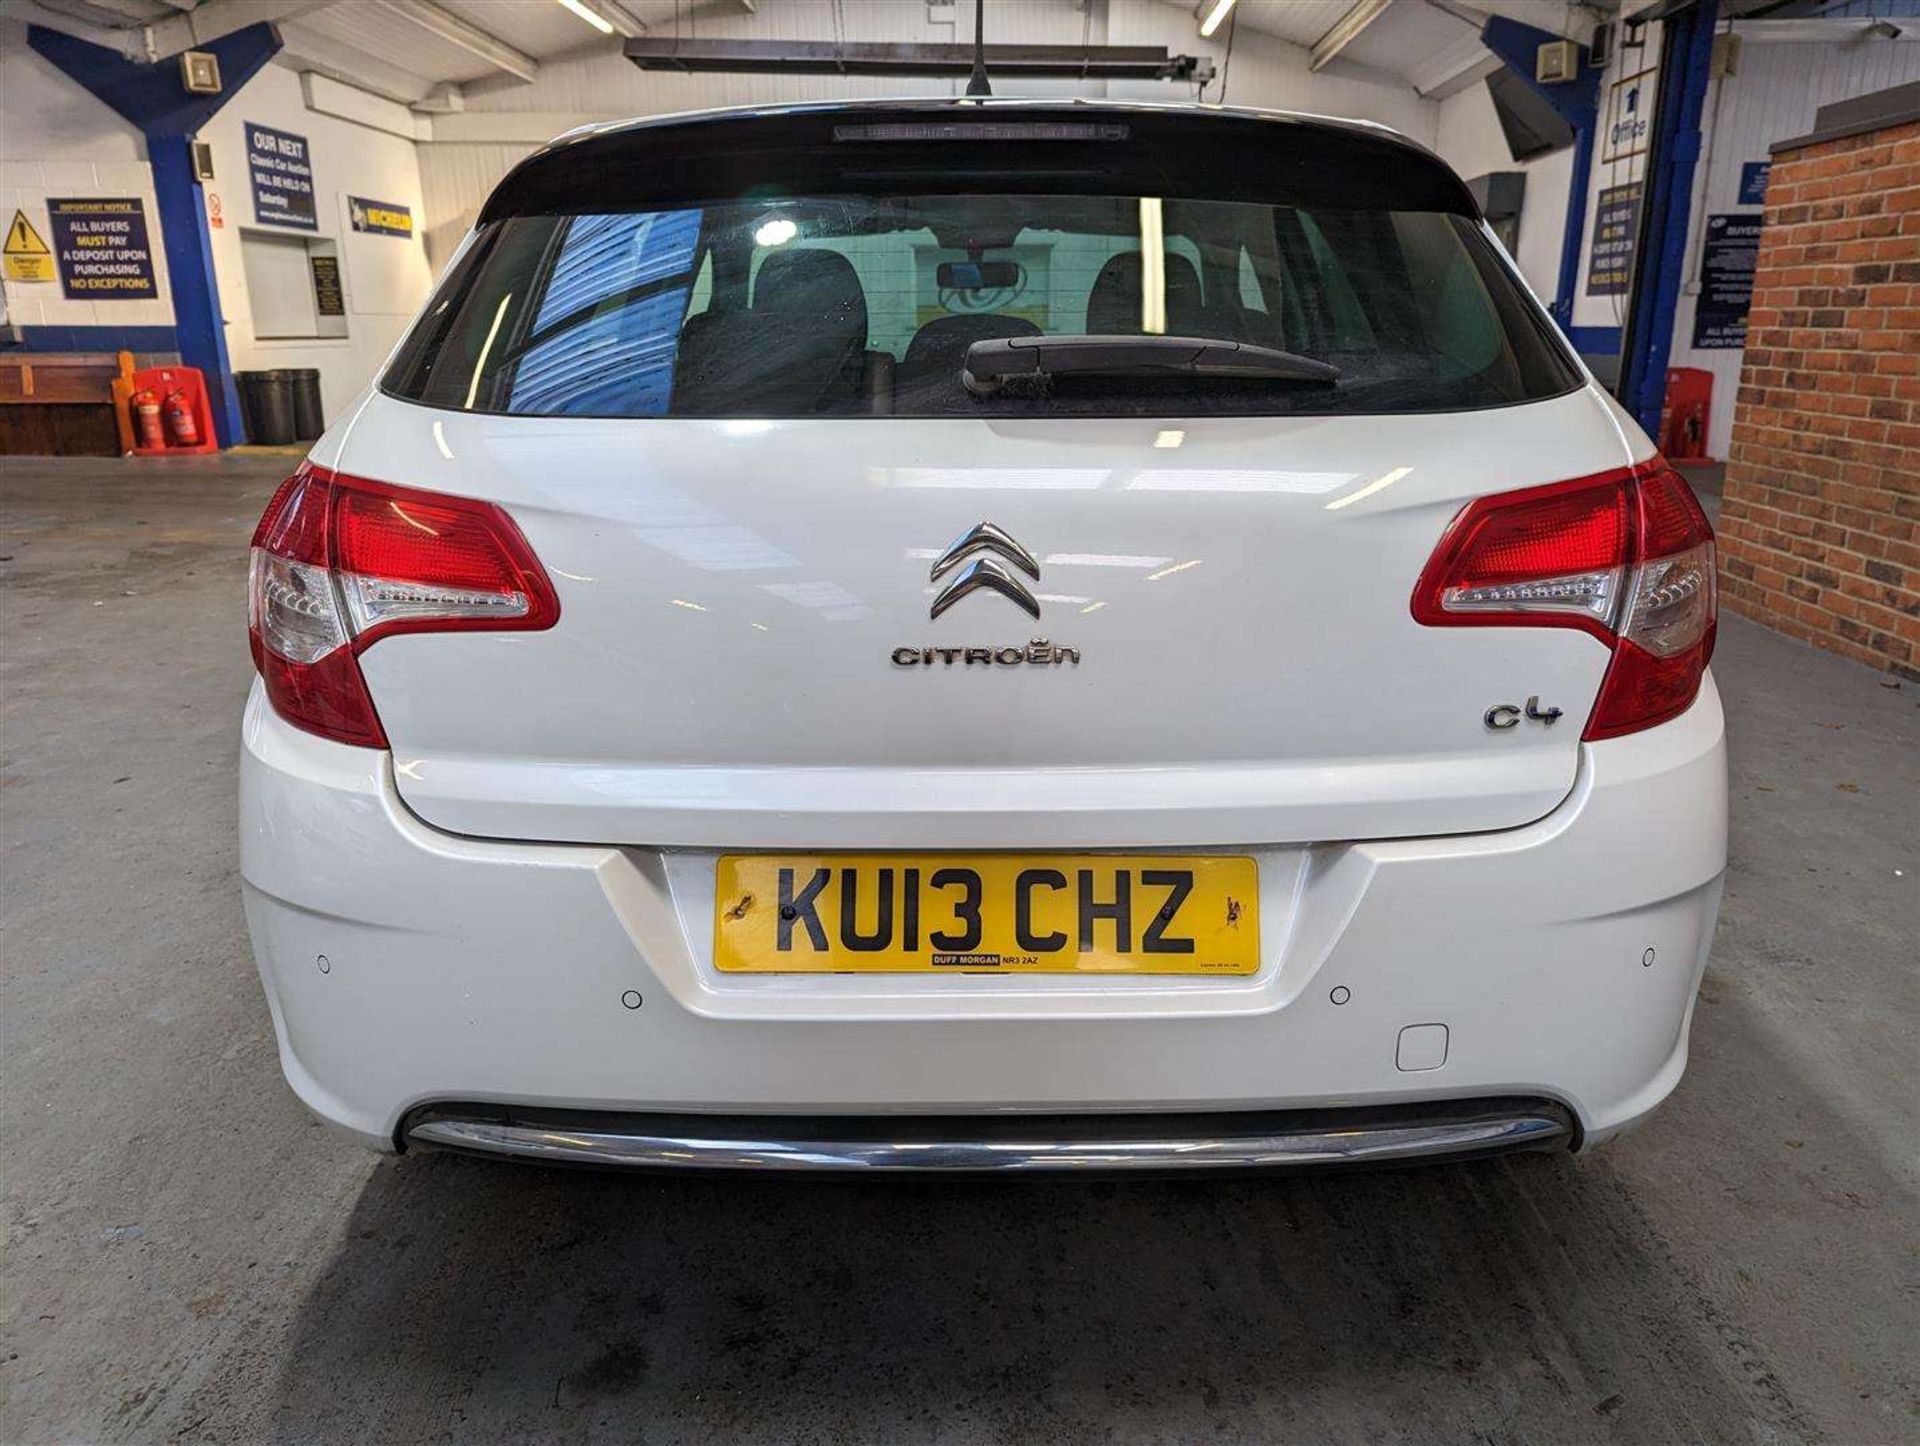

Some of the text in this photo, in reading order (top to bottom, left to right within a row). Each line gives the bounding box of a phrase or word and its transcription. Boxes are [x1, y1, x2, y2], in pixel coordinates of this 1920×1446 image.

[1611, 120, 1646, 146] Office
[254, 131, 303, 158] OUR NEXT
[255, 172, 272, 186] WILL
[272, 175, 283, 187] BE
[59, 203, 132, 212] IMPORTANT NOTICE
[70, 221, 130, 232] ALL BUYERS
[1726, 226, 1762, 236] BUYER
[76, 236, 128, 246] MUST PAY
[63, 251, 147, 261] A DEPOSIT UPON
[74, 264, 141, 275] PURCHASING
[70, 279, 149, 290] NO EXCEPTIONS
[1484, 696, 1564, 729] C4
[776, 868, 1195, 954] KU13 CHZ
[934, 955, 1039, 965] DUFF MORGAN NR3 2AZ
